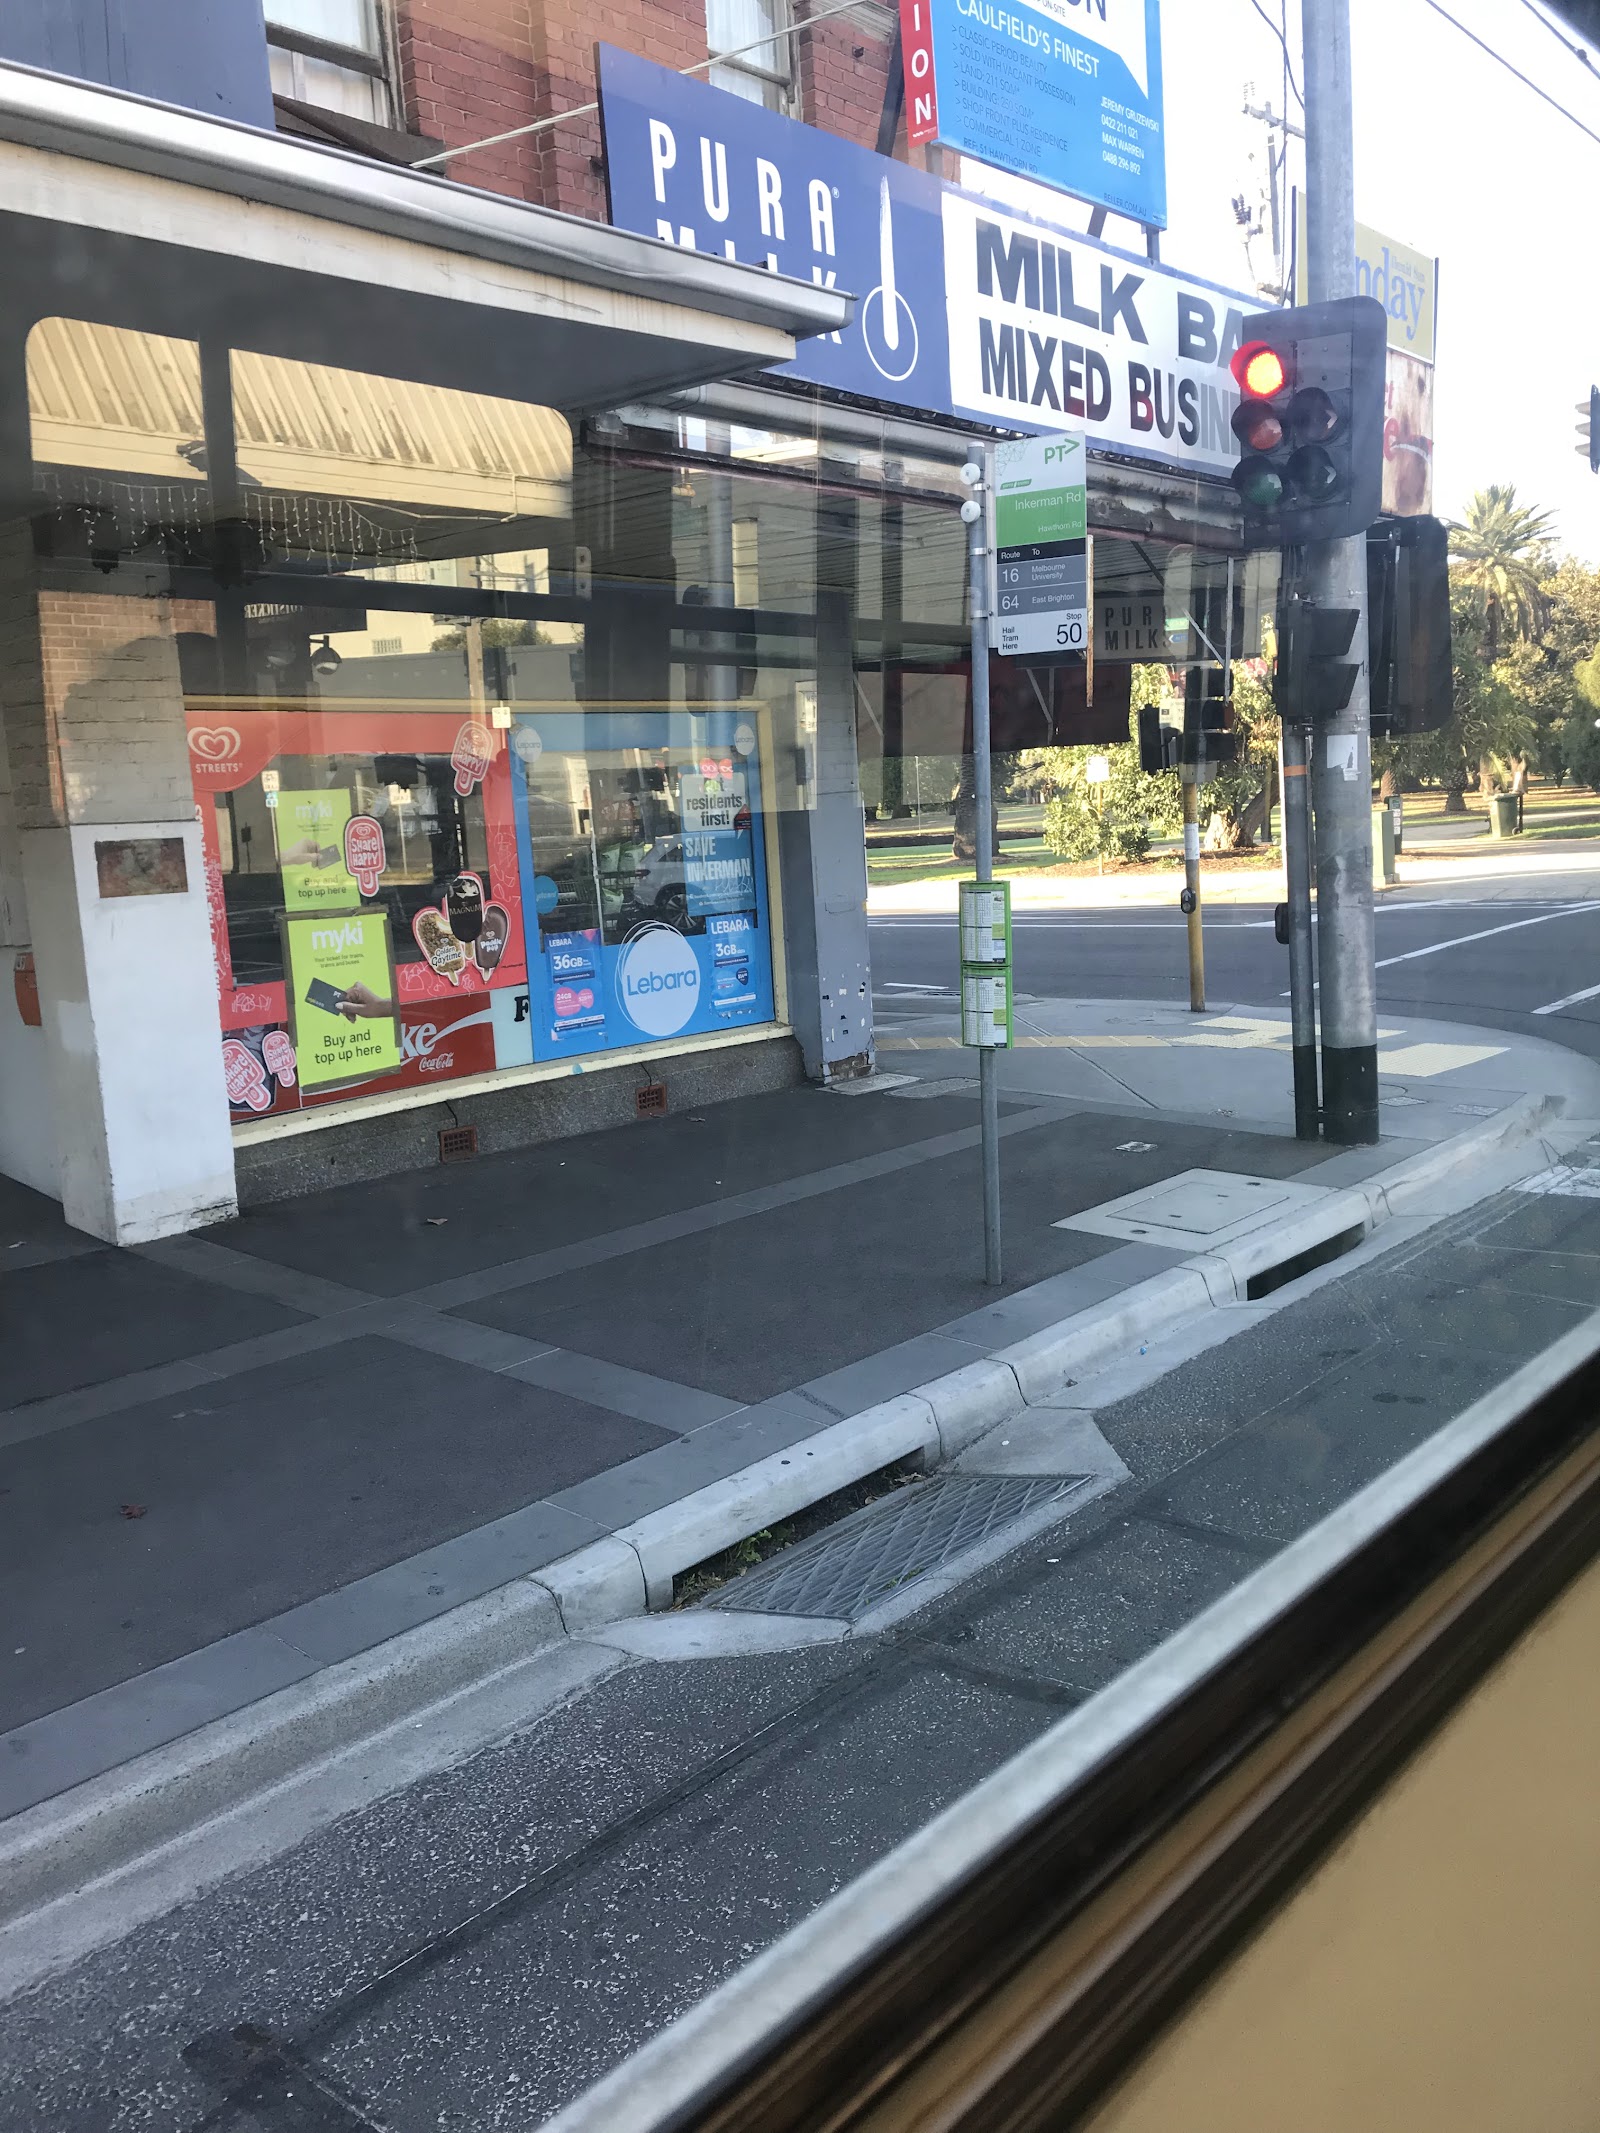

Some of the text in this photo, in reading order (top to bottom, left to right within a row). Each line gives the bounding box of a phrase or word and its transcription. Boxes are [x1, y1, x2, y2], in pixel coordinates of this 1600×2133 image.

[956, 0, 1050, 54] CAULFIELD'S
[1054, 38, 1099, 78] FINEST
[959, 26, 1047, 74] CLASSIC PERIOD BEAUTY
[959, 43, 1075, 106] SOLD WITH VACANT POSSESSION
[961, 63, 984, 81] LAND:
[986, 73, 998, 88] 211
[961, 80, 999, 105] BUILDING:
[1101, 96, 1124, 116] JEREMY
[962, 98, 1067, 152] SHOP FRONT PLUS RESIDENCE
[1101, 114, 1116, 130] 0422
[1117, 120, 1127, 135] 211
[963, 116, 1014, 146] COMMERCIAL
[1021, 140, 1041, 157] ZONE
[1102, 131, 1144, 159] MAX WARREN
[989, 148, 1028, 171] HAWTHORN
[1029, 162, 1038, 174] RD
[975, 217, 1243, 369] MILK BA
[979, 316, 1112, 422] MIXED
[1015, 491, 1081, 510] Inkerman Rd
[1038, 520, 1082, 533] Hawthorn Rd
[1001, 548, 1040, 559] Route To
[1002, 568, 1019, 583] 16
[1032, 563, 1066, 573] Melbourne
[1032, 571, 1063, 581] University
[1002, 593, 1075, 610] 64 East Brighton
[1066, 612, 1082, 621] Stop
[1002, 626, 1015, 634] Hail
[1056, 622, 1082, 645] 50
[1105, 629, 1158, 650] MILK
[1002, 642, 1018, 650] Here
[195, 762, 239, 774] STREETS
[686, 793, 742, 811] residents
[295, 801, 333, 823] myki
[700, 811, 730, 827] first!
[685, 836, 717, 858] SAVE
[686, 858, 751, 883] INKERMAN
[298, 886, 346, 899] top up here
[450, 904, 482, 915] MAGNUM
[711, 918, 750, 935] LEBARA
[312, 921, 363, 953] myki
[549, 938, 572, 948] LEBARA
[431, 951, 461, 966] Gaytime
[436, 946, 455, 957] Golden
[715, 943, 737, 957] 3GB
[553, 954, 583, 971] 36GB
[626, 970, 697, 996] Lebara
[324, 1029, 371, 1048] Buy and
[315, 1045, 382, 1065] top up here
